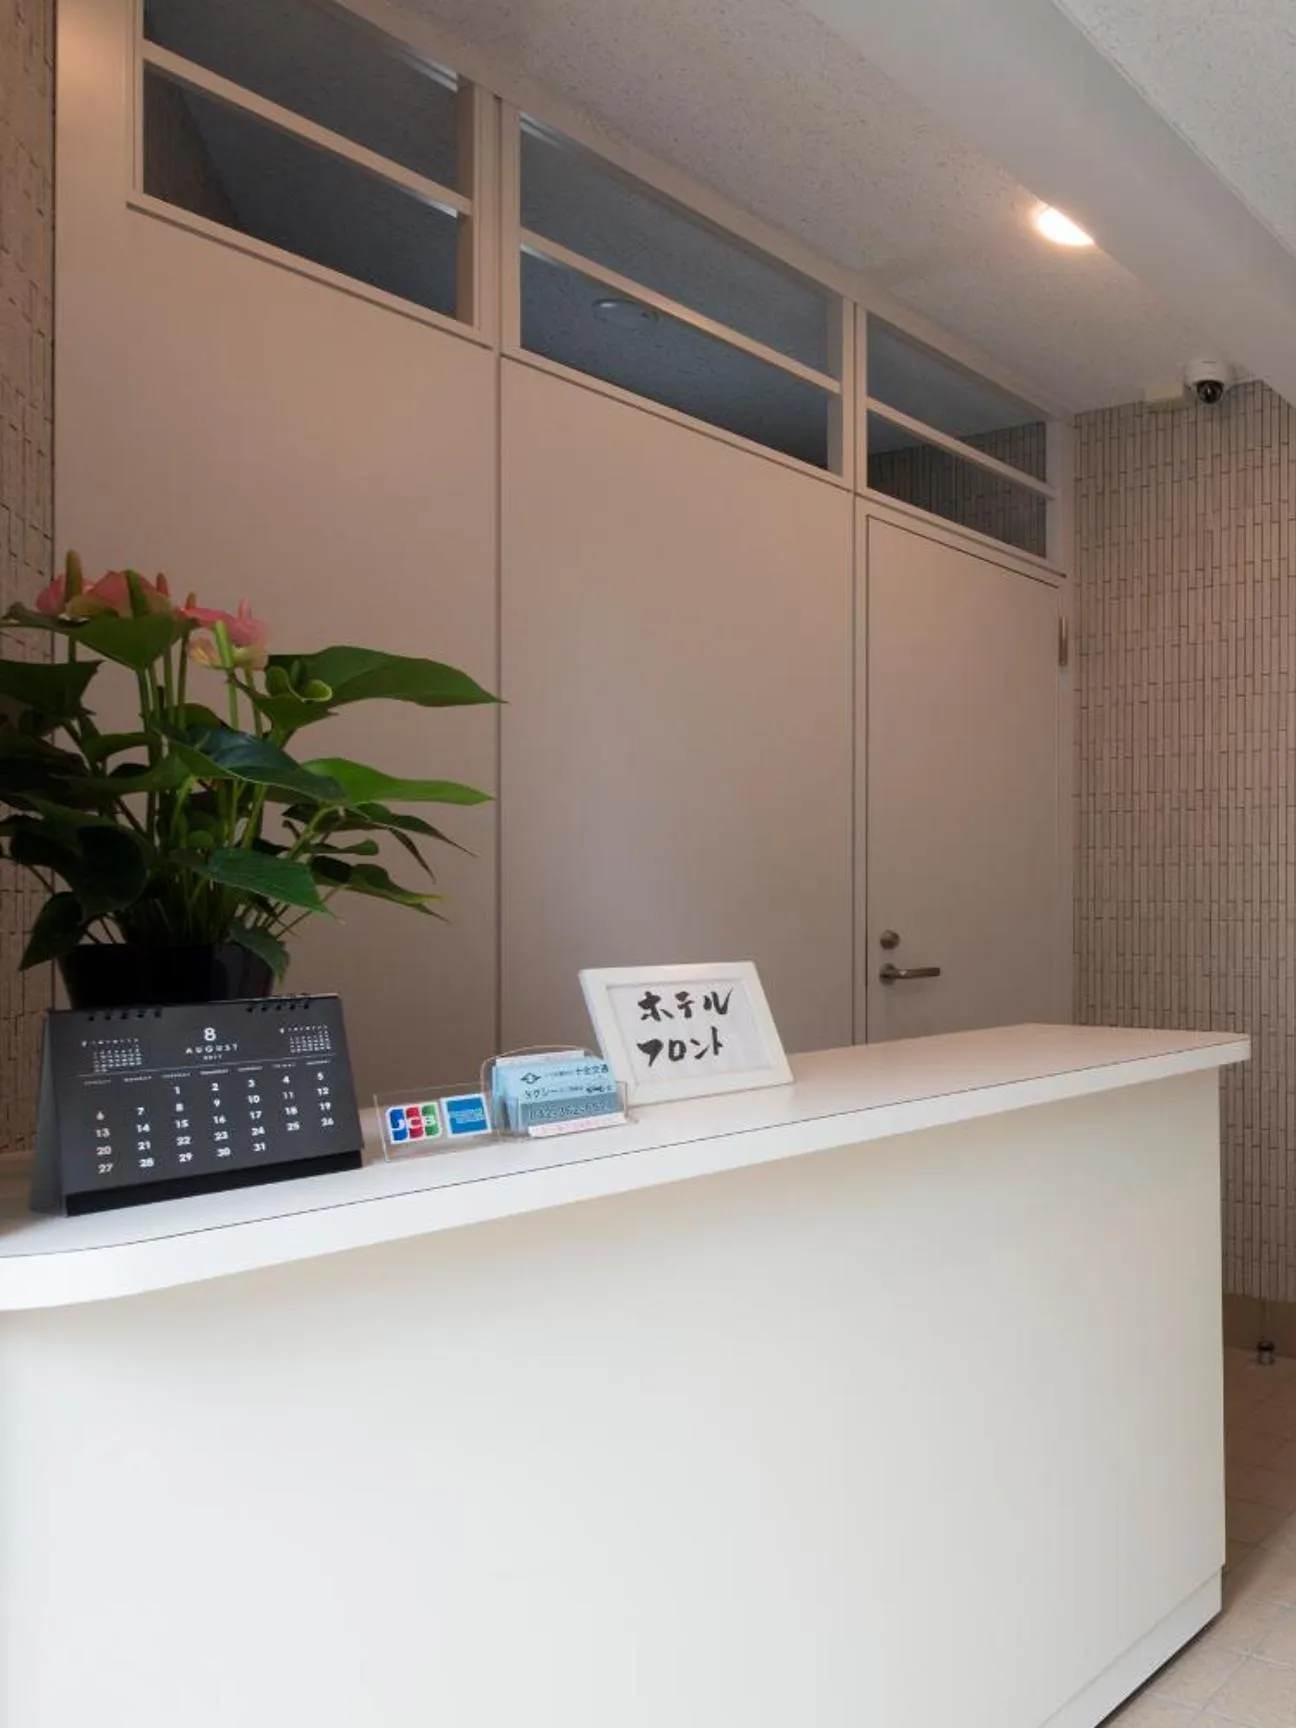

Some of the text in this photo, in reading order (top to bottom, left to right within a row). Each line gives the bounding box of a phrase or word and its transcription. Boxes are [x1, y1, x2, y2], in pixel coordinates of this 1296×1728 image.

[637, 988, 734, 1022] ホテル
[204, 1027, 217, 1042] 8
[636, 1026, 724, 1067] フロント
[174, 1071, 324, 1095] 1 2 3 4 5
[95, 1127, 111, 1138] 13
[137, 1123, 150, 1133] 14
[175, 1119, 189, 1129] 15
[213, 1115, 226, 1124] 16
[249, 1110, 262, 1120] 17
[319, 1101, 331, 1111] 19
[96, 1111, 105, 1121] 6
[137, 1106, 145, 1116] 7
[213, 1099, 221, 1107] 9
[247, 1094, 261, 1104] 10
[283, 1091, 294, 1100] 11
[316, 1086, 329, 1096] 12
[96, 1145, 112, 1156] 20
[137, 1140, 151, 1151] 21
[251, 1126, 265, 1136] 24
[320, 1117, 334, 1127] 26
[391, 1115, 433, 1131] JCB
[98, 1163, 114, 1174] 27
[178, 1152, 193, 1163] 29
[217, 1146, 231, 1158] 30
[253, 1142, 266, 1152] 31
